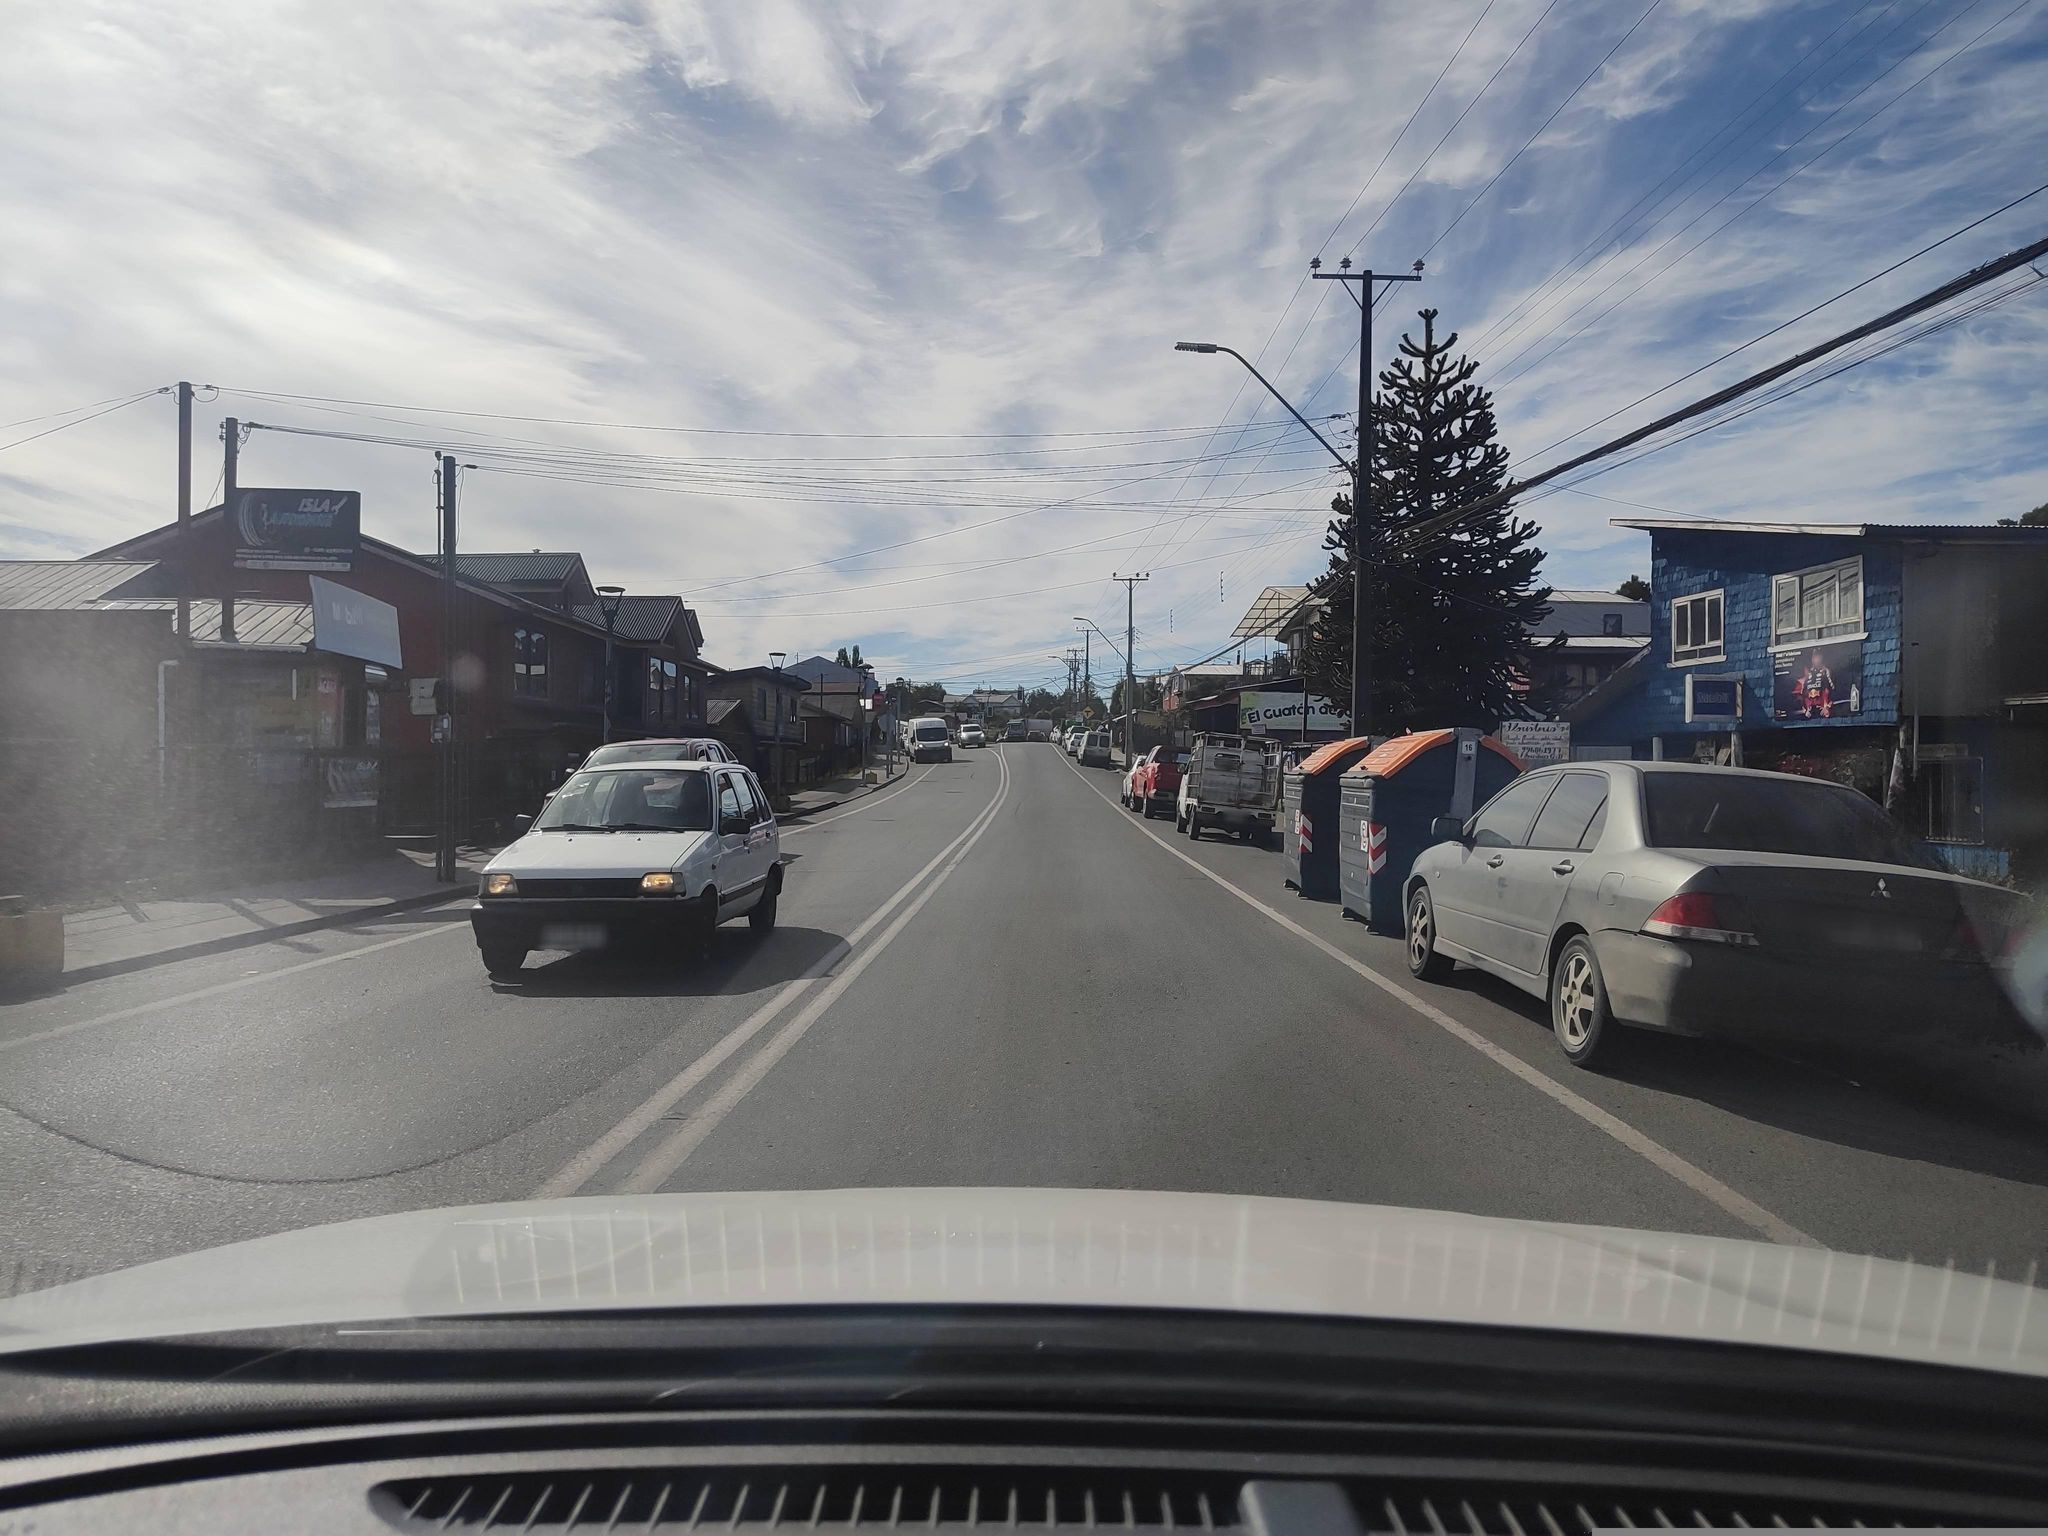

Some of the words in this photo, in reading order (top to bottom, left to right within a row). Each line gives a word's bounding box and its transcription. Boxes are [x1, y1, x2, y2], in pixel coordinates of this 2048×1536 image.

[298, 498, 331, 512] ISLA
[1247, 710, 1260, 723] El
[1464, 743, 1473, 752] 16
